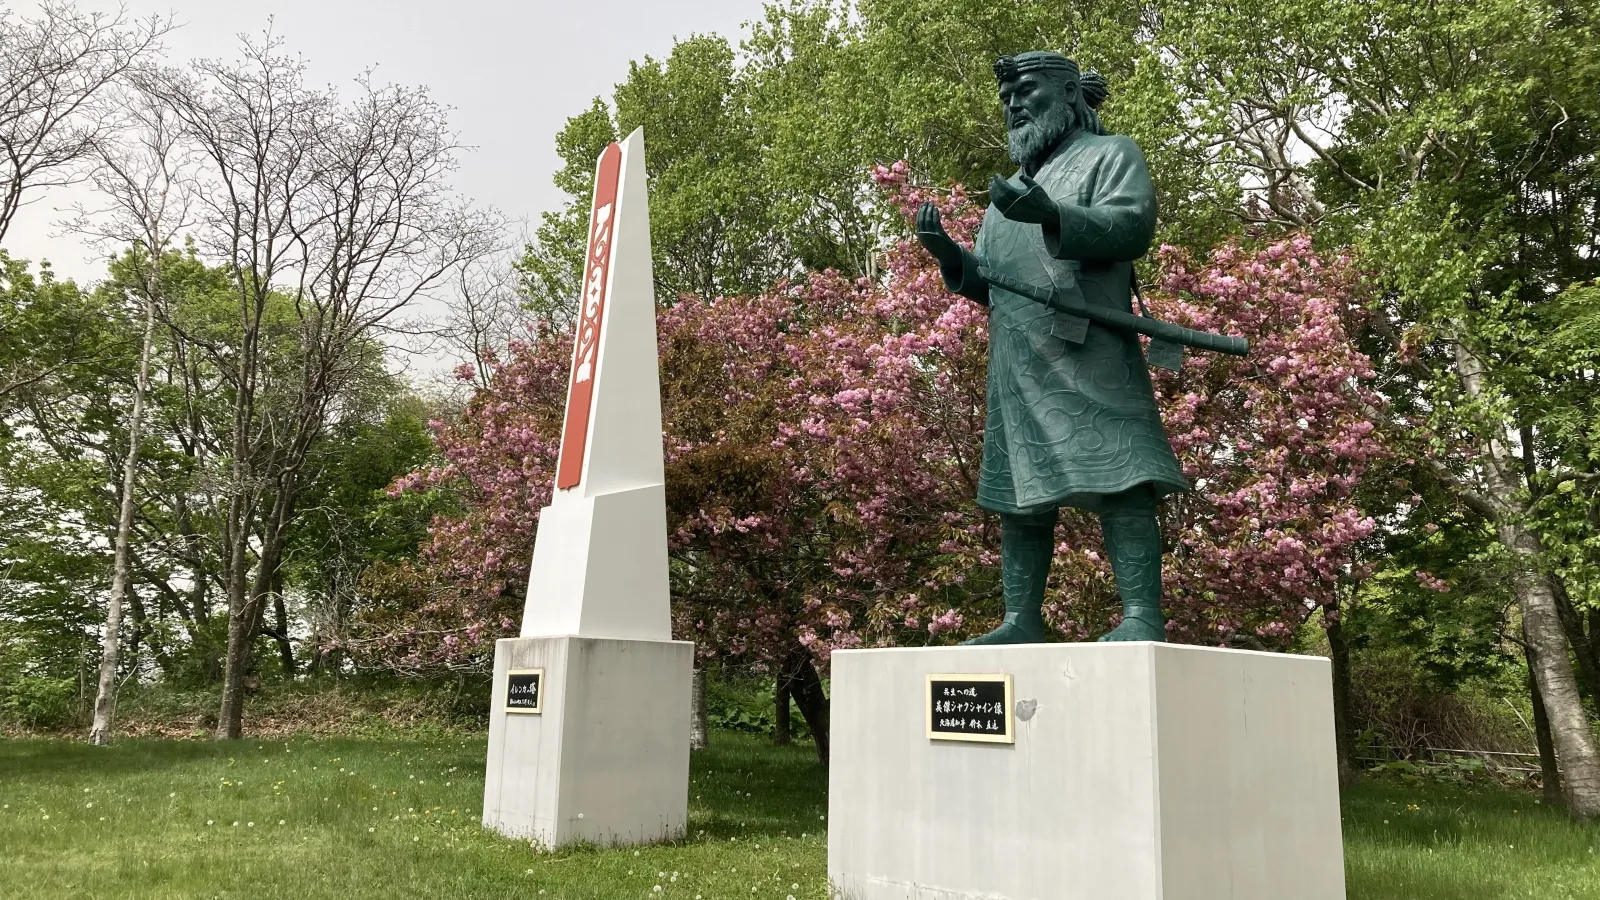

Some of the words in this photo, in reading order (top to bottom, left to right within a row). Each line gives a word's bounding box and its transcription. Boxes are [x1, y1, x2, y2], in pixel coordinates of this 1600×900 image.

[935, 699, 1003, 715] 英傑シャクシャイン像
